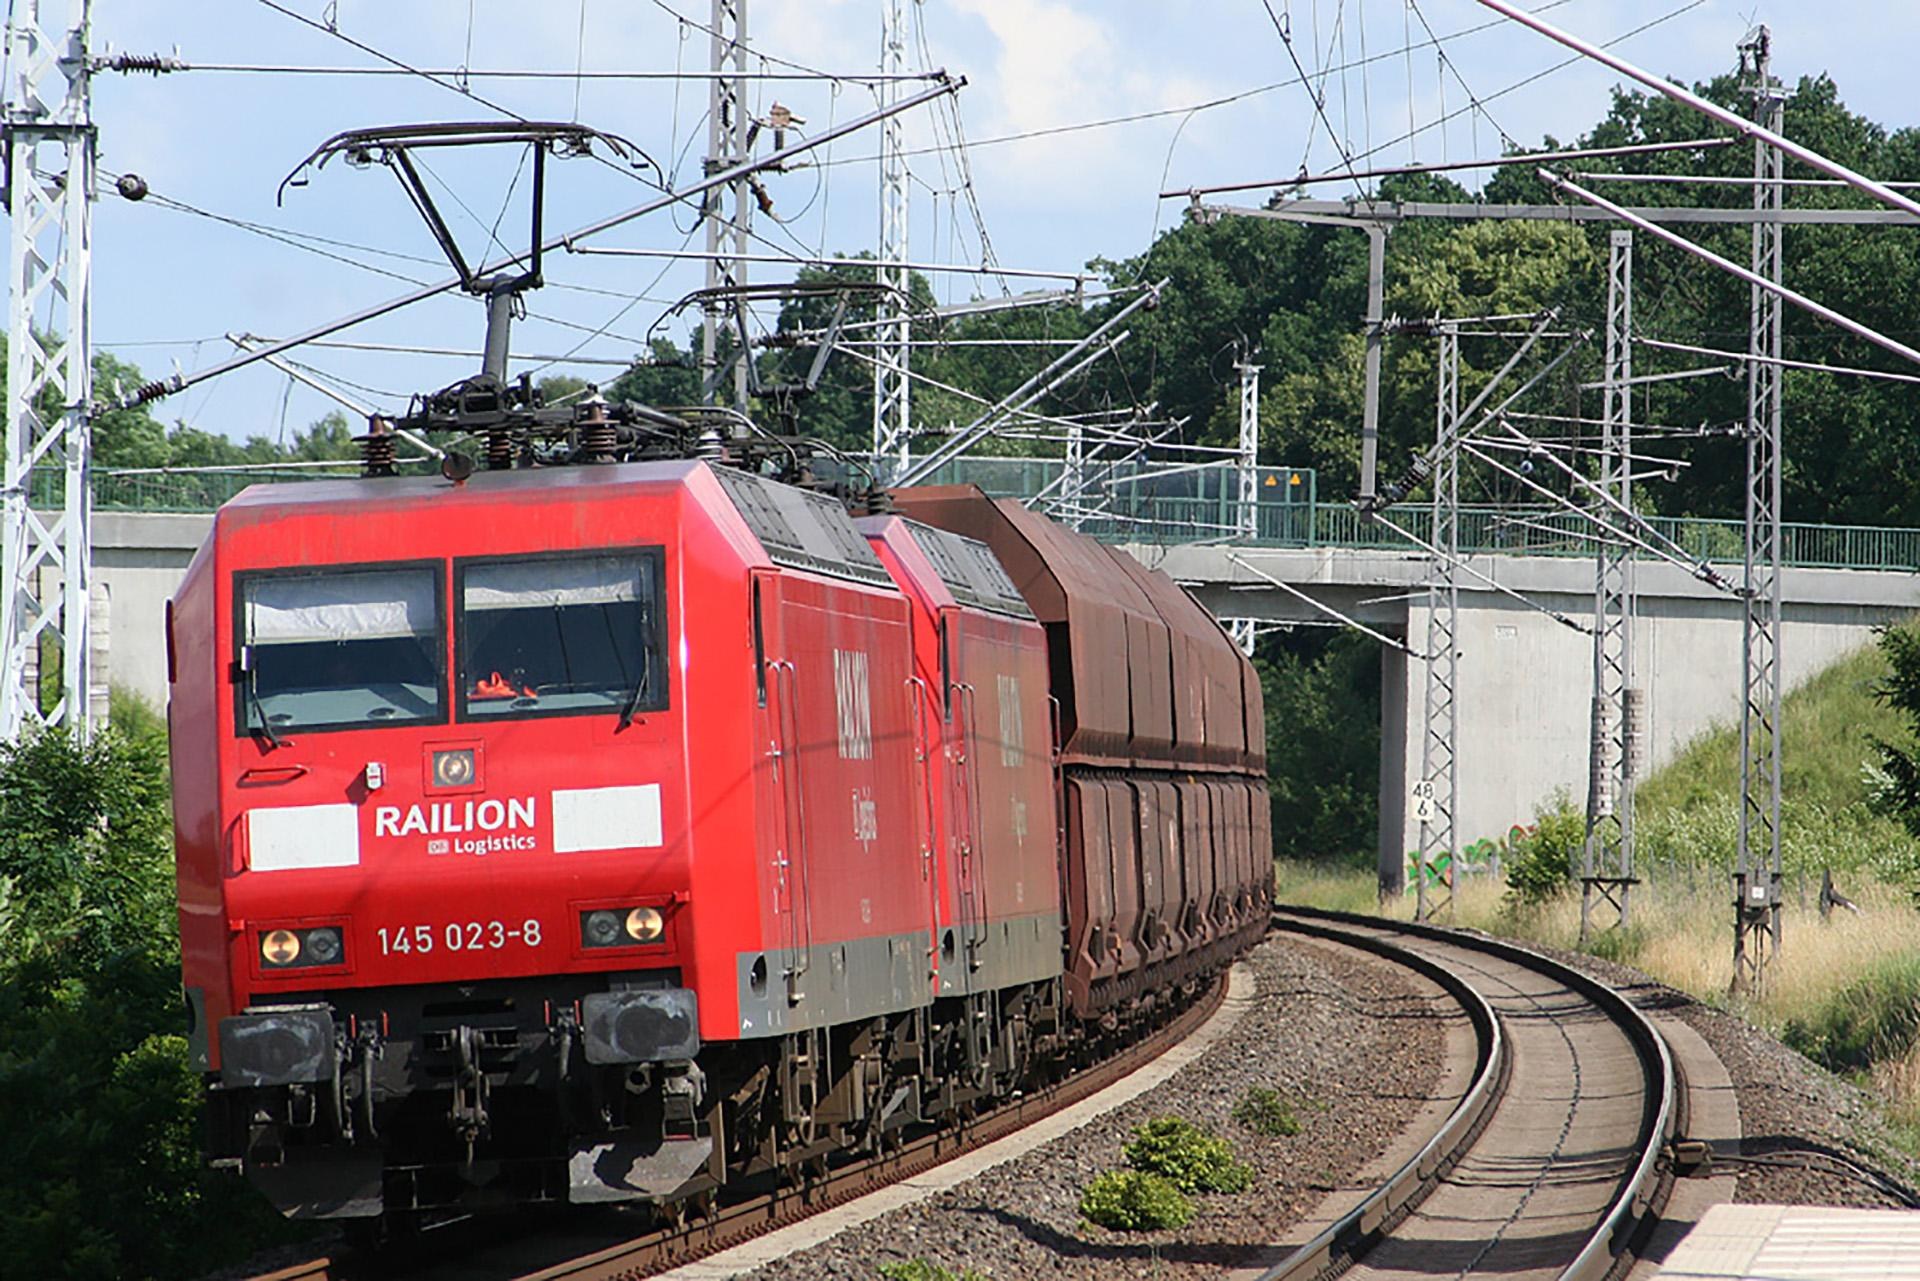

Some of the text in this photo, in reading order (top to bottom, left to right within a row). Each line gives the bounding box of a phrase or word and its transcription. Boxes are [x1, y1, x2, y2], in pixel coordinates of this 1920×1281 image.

[1413, 783, 1434, 799] 48
[375, 797, 535, 837] RAILION
[1417, 800, 1428, 816] 6
[454, 834, 536, 855] Logistics
[377, 919, 542, 956] 145 023-8
